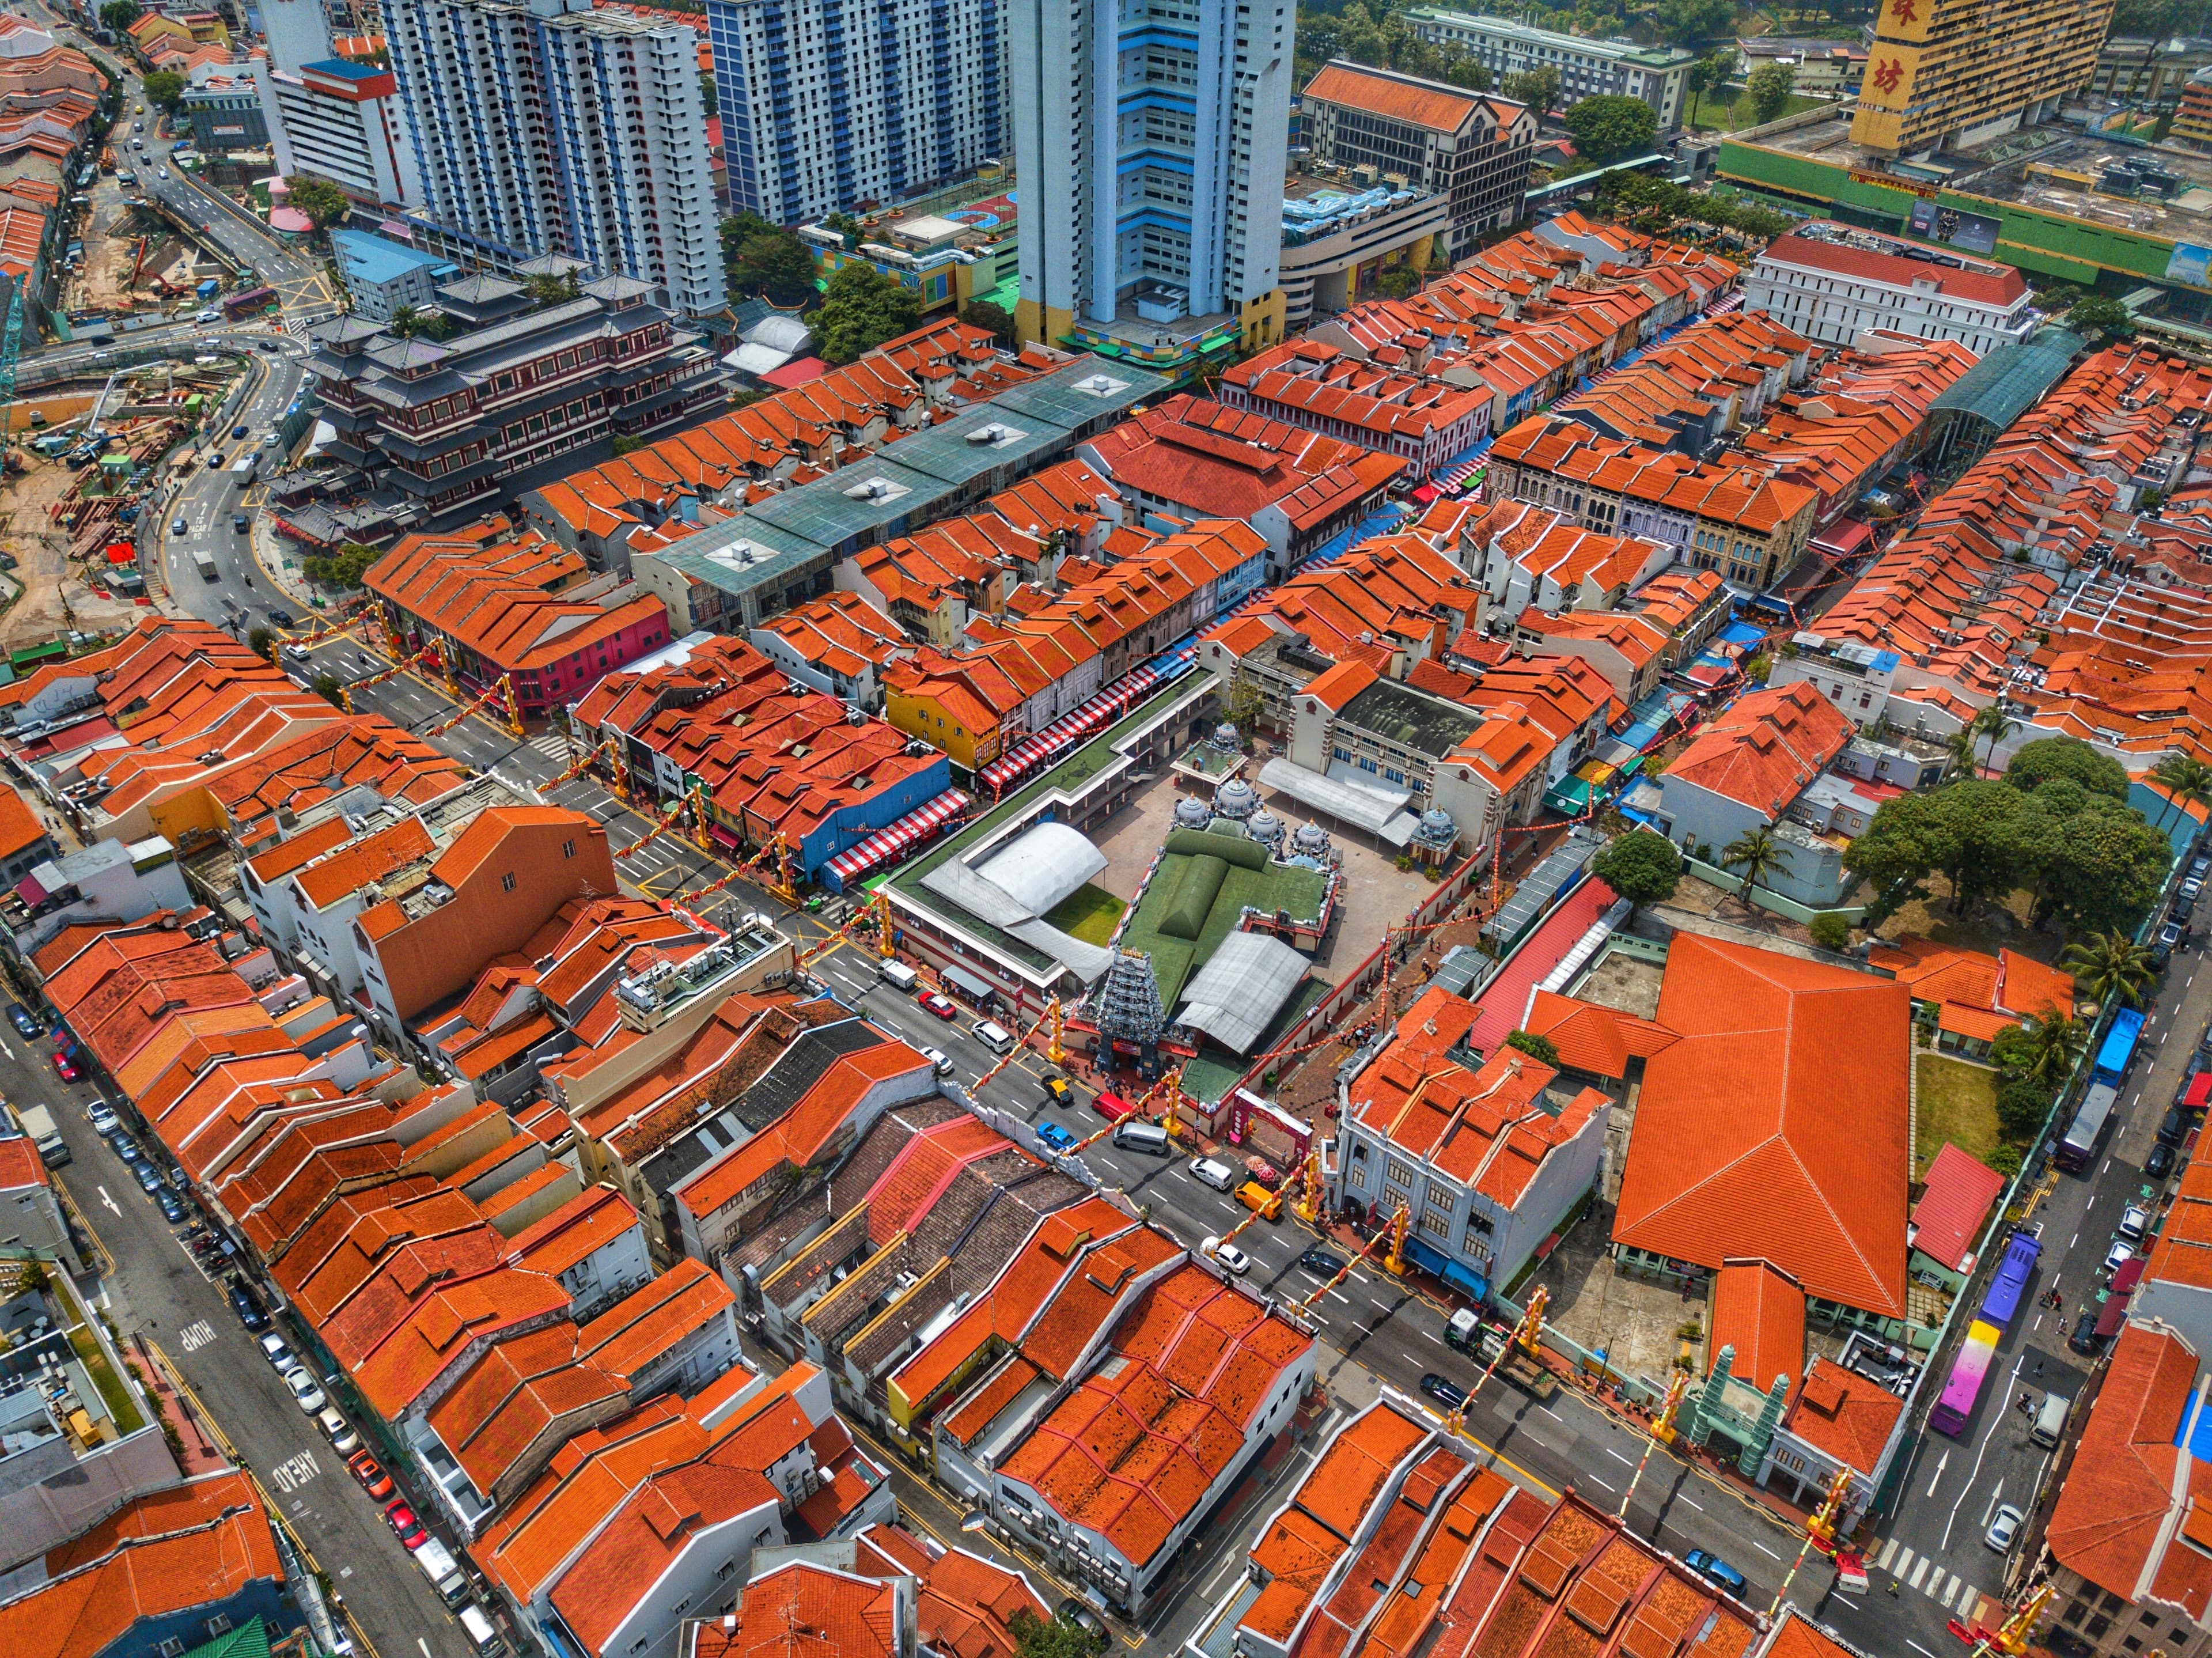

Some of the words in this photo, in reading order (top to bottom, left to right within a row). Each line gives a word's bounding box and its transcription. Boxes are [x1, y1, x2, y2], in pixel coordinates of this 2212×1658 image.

[196, 516, 204, 524] TG
[188, 524, 207, 533] PAGAR
[169, 535, 179, 543] RD
[193, 532, 202, 540] RD
[179, 1319, 217, 1352] HUMP
[272, 1449, 321, 1493] AHEAD
